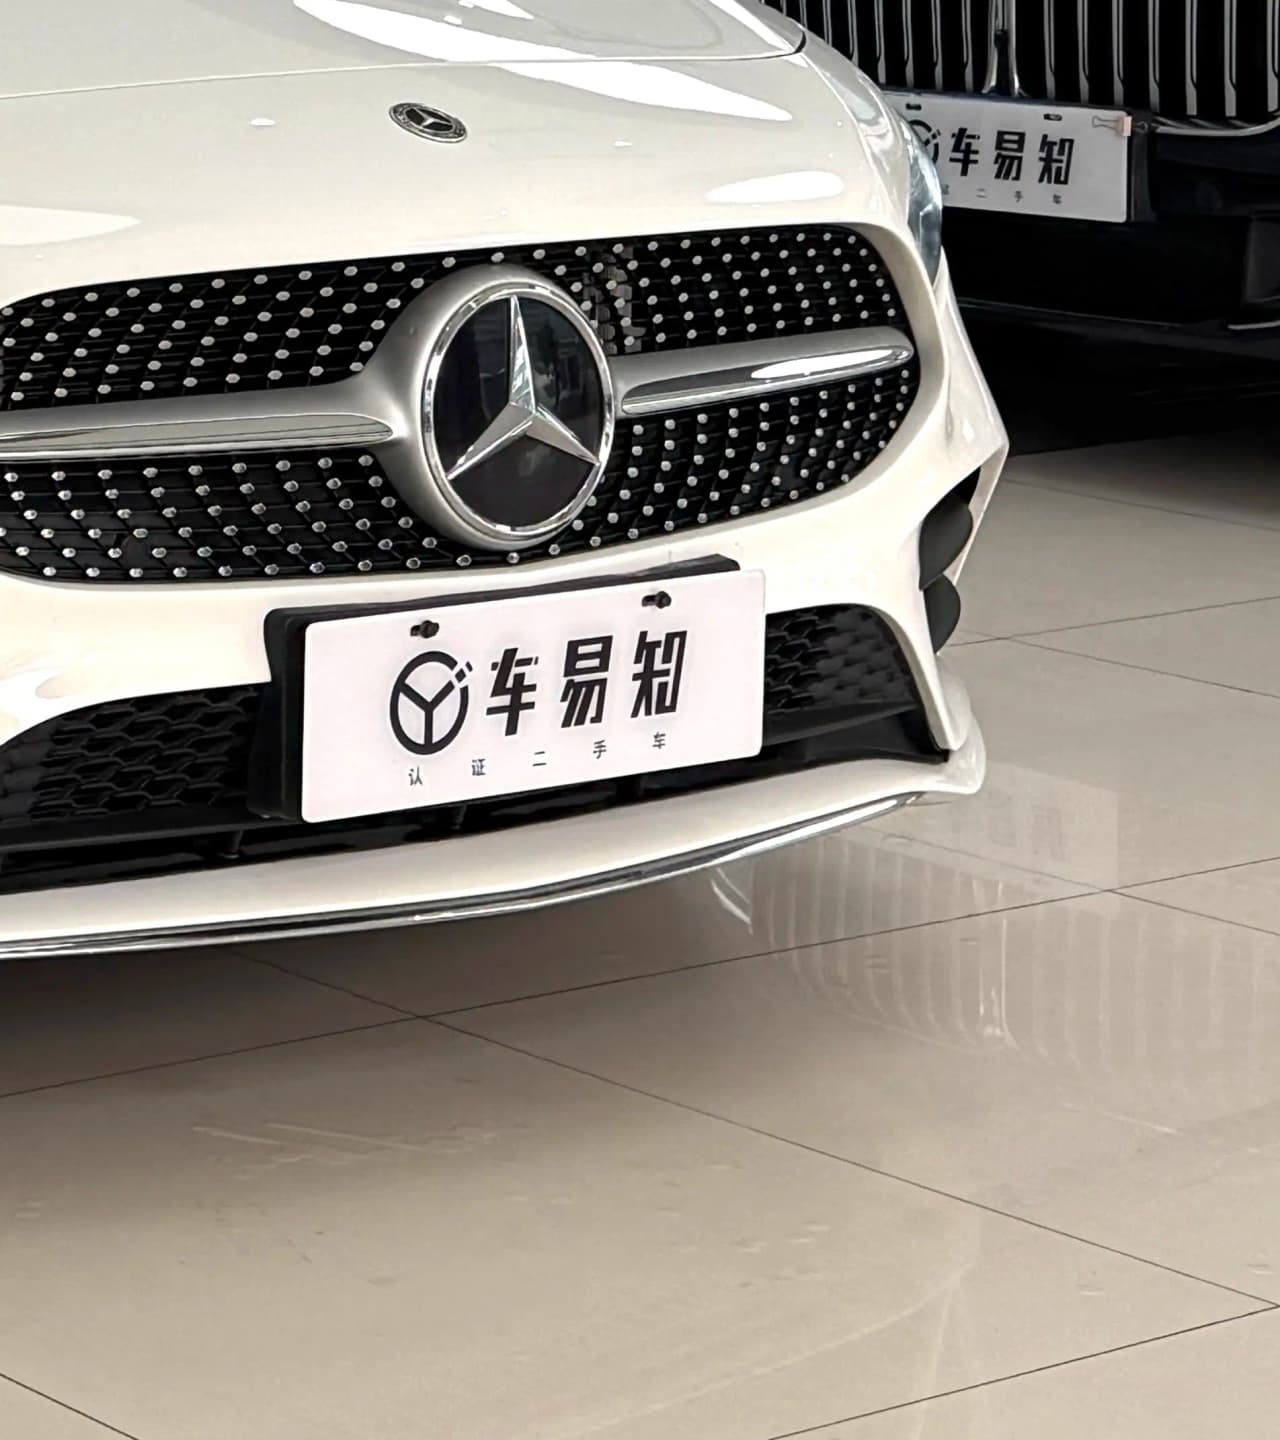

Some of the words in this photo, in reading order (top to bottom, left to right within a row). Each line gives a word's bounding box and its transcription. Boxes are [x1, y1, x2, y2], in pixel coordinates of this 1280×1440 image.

[949, 127, 1075, 186] 车易知
[486, 630, 688, 737] 车易知
[407, 731, 668, 787] 认证二手车
